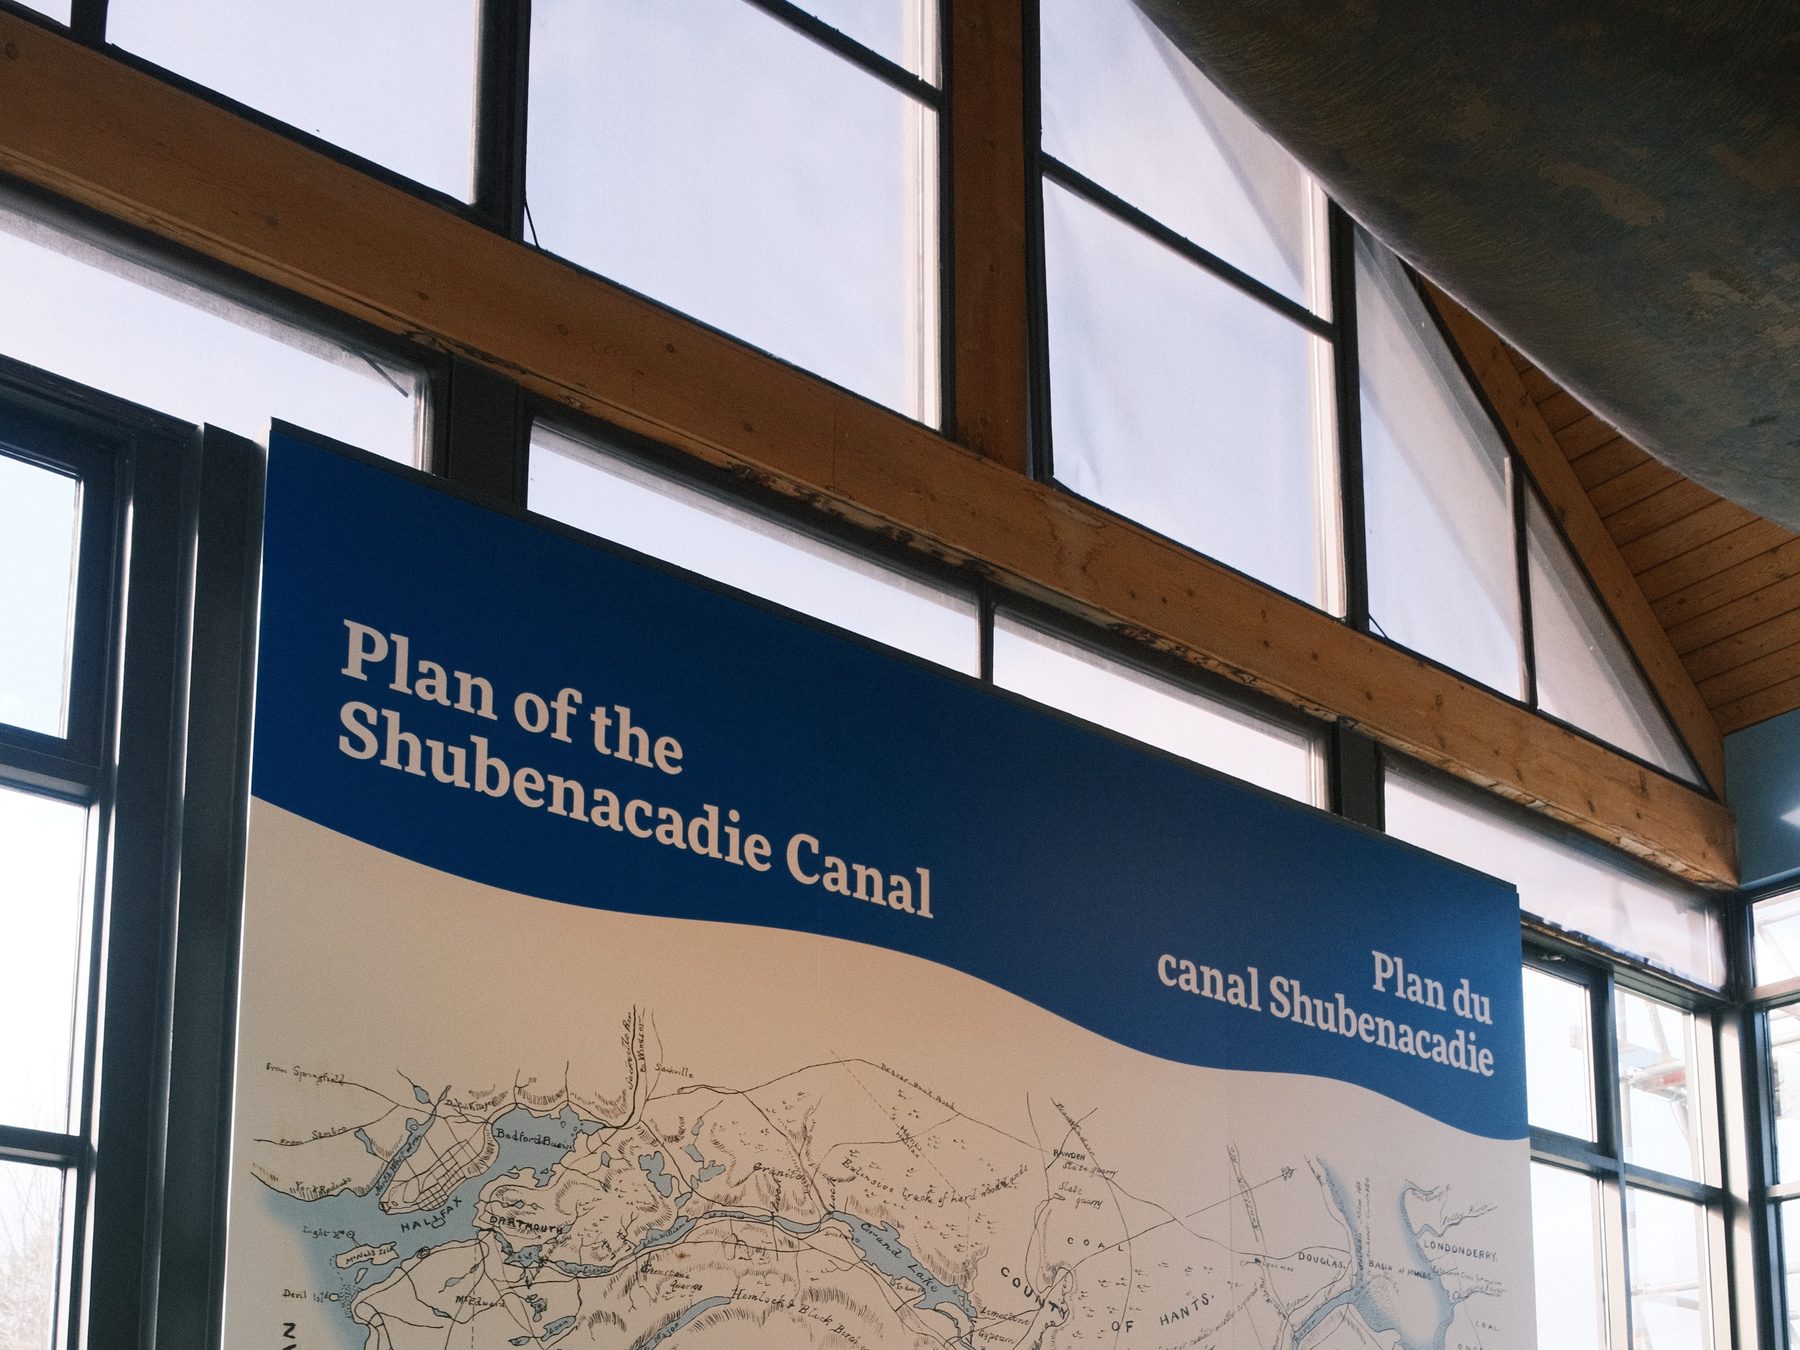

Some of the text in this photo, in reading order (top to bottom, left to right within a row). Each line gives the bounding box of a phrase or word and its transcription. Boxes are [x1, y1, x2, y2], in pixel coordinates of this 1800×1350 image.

[342, 619, 684, 775] Plan of the
[339, 701, 933, 919] Shubenacadie Canal
[1372, 950, 1493, 1025] Plan du
[1157, 953, 1494, 1077] canal Shubenacadie
[494, 1128, 541, 1144] Bedford
[1053, 1149, 1086, 1161] RAWDEN
[401, 1196, 462, 1232] HALIFAX
[490, 1215, 563, 1236] DARTMOUTH
[861, 1222, 939, 1292] Grand Lake
[1067, 1237, 1124, 1252] COAL
[730, 1287, 786, 1308] Hemlock
[798, 1304, 833, 1326] Black
[1112, 1321, 1134, 1333] OF
[1475, 1321, 1499, 1332] COAL
